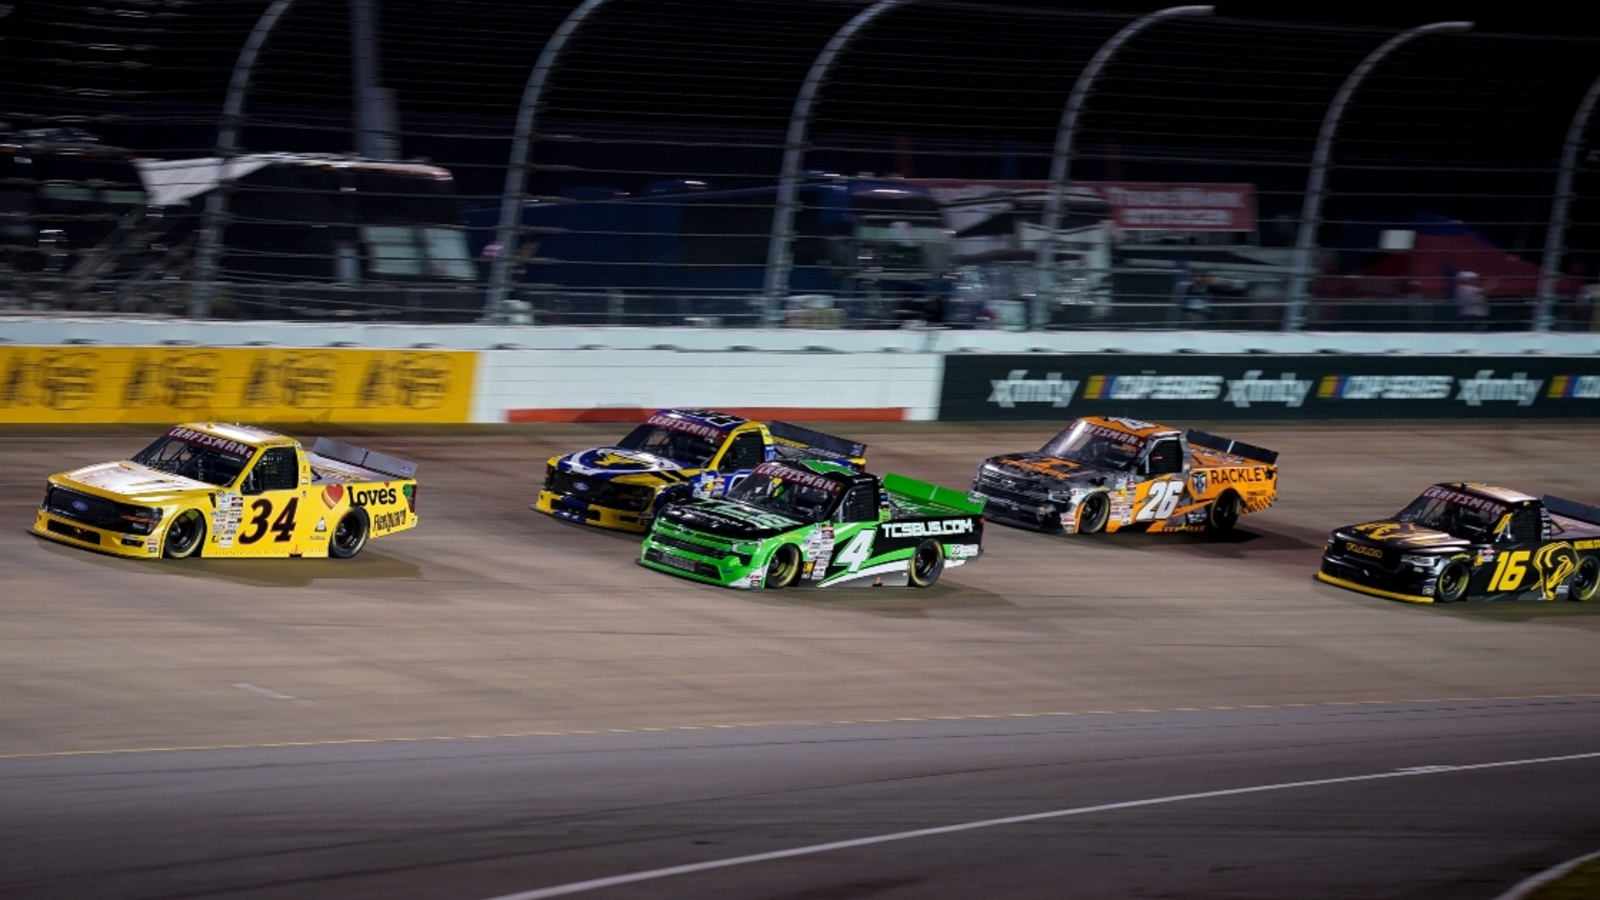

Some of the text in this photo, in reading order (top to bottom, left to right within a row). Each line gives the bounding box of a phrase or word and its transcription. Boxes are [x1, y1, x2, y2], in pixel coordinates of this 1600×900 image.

[647, 415, 719, 438] CRAFTSMAN
[169, 427, 248, 455] CRAFTSMAN
[758, 465, 837, 490] CRAFTSMAN
[1135, 481, 1184, 520] 26
[1424, 488, 1503, 514] CRAFTSMAN
[238, 497, 298, 544] 34
[881, 518, 973, 538] TCSBUS.COM
[835, 528, 876, 573] 4
[1487, 551, 1530, 592] 16
